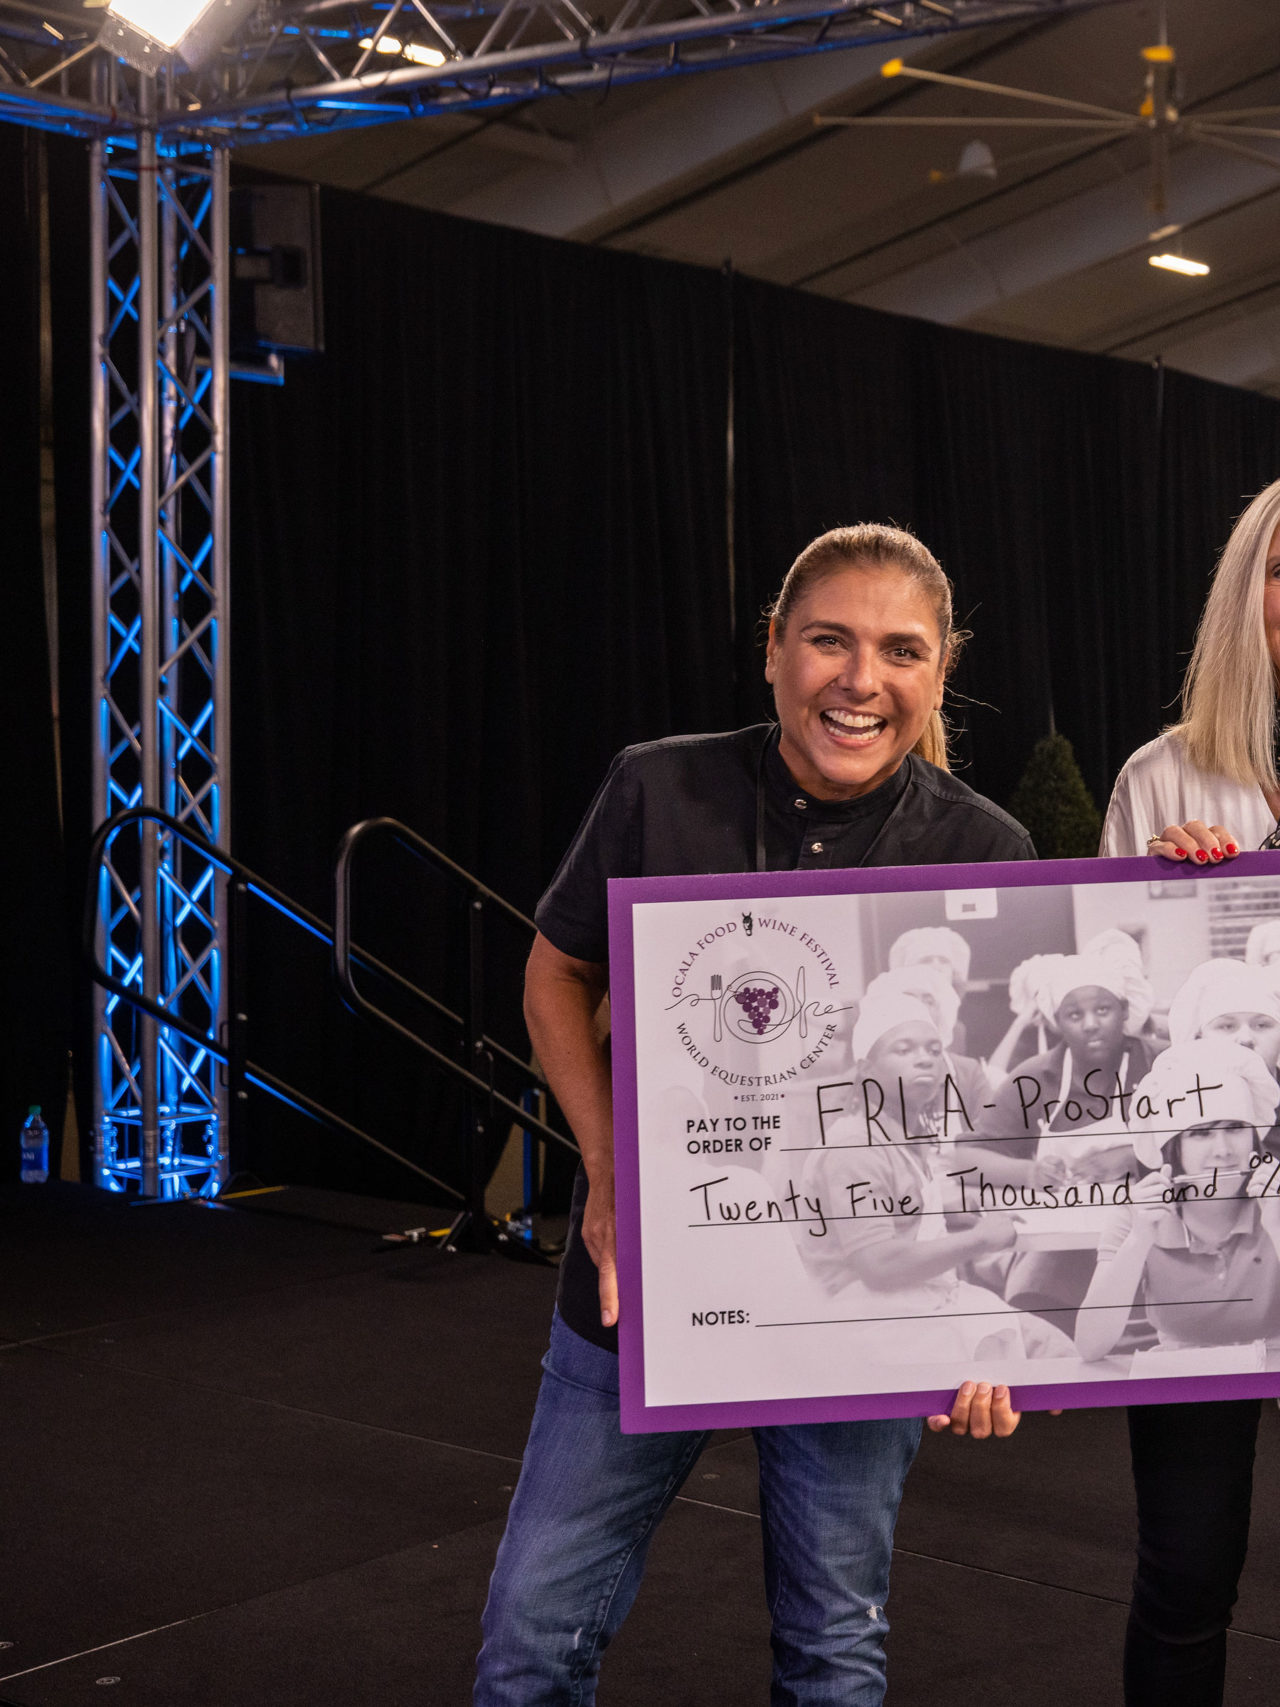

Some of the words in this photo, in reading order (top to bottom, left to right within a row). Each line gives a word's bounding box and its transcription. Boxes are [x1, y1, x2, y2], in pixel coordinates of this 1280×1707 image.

[671, 951, 699, 998] OCALA
[696, 921, 737, 950] FOOD
[758, 917, 798, 937] WINE
[799, 932, 840, 989] FESTIVAL
[676, 1022, 710, 1069] WORLD
[710, 1065, 798, 1087] EQUESTRIAN
[800, 1023, 838, 1070] CENTER
[740, 1094, 757, 1102] EST.
[760, 1093, 779, 1101] 2021
[686, 1118, 720, 1134] PAY
[724, 1117, 747, 1132] TO
[752, 1115, 781, 1131] THE
[686, 1138, 746, 1155] ORDER
[749, 1137, 772, 1152] OF
[690, 1176, 827, 1237] Twenty
[846, 1181, 920, 1217] Five
[946, 1166, 1133, 1213] Thousand
[1162, 1167, 1218, 1204] and
[691, 1309, 750, 1327] NOTES:
